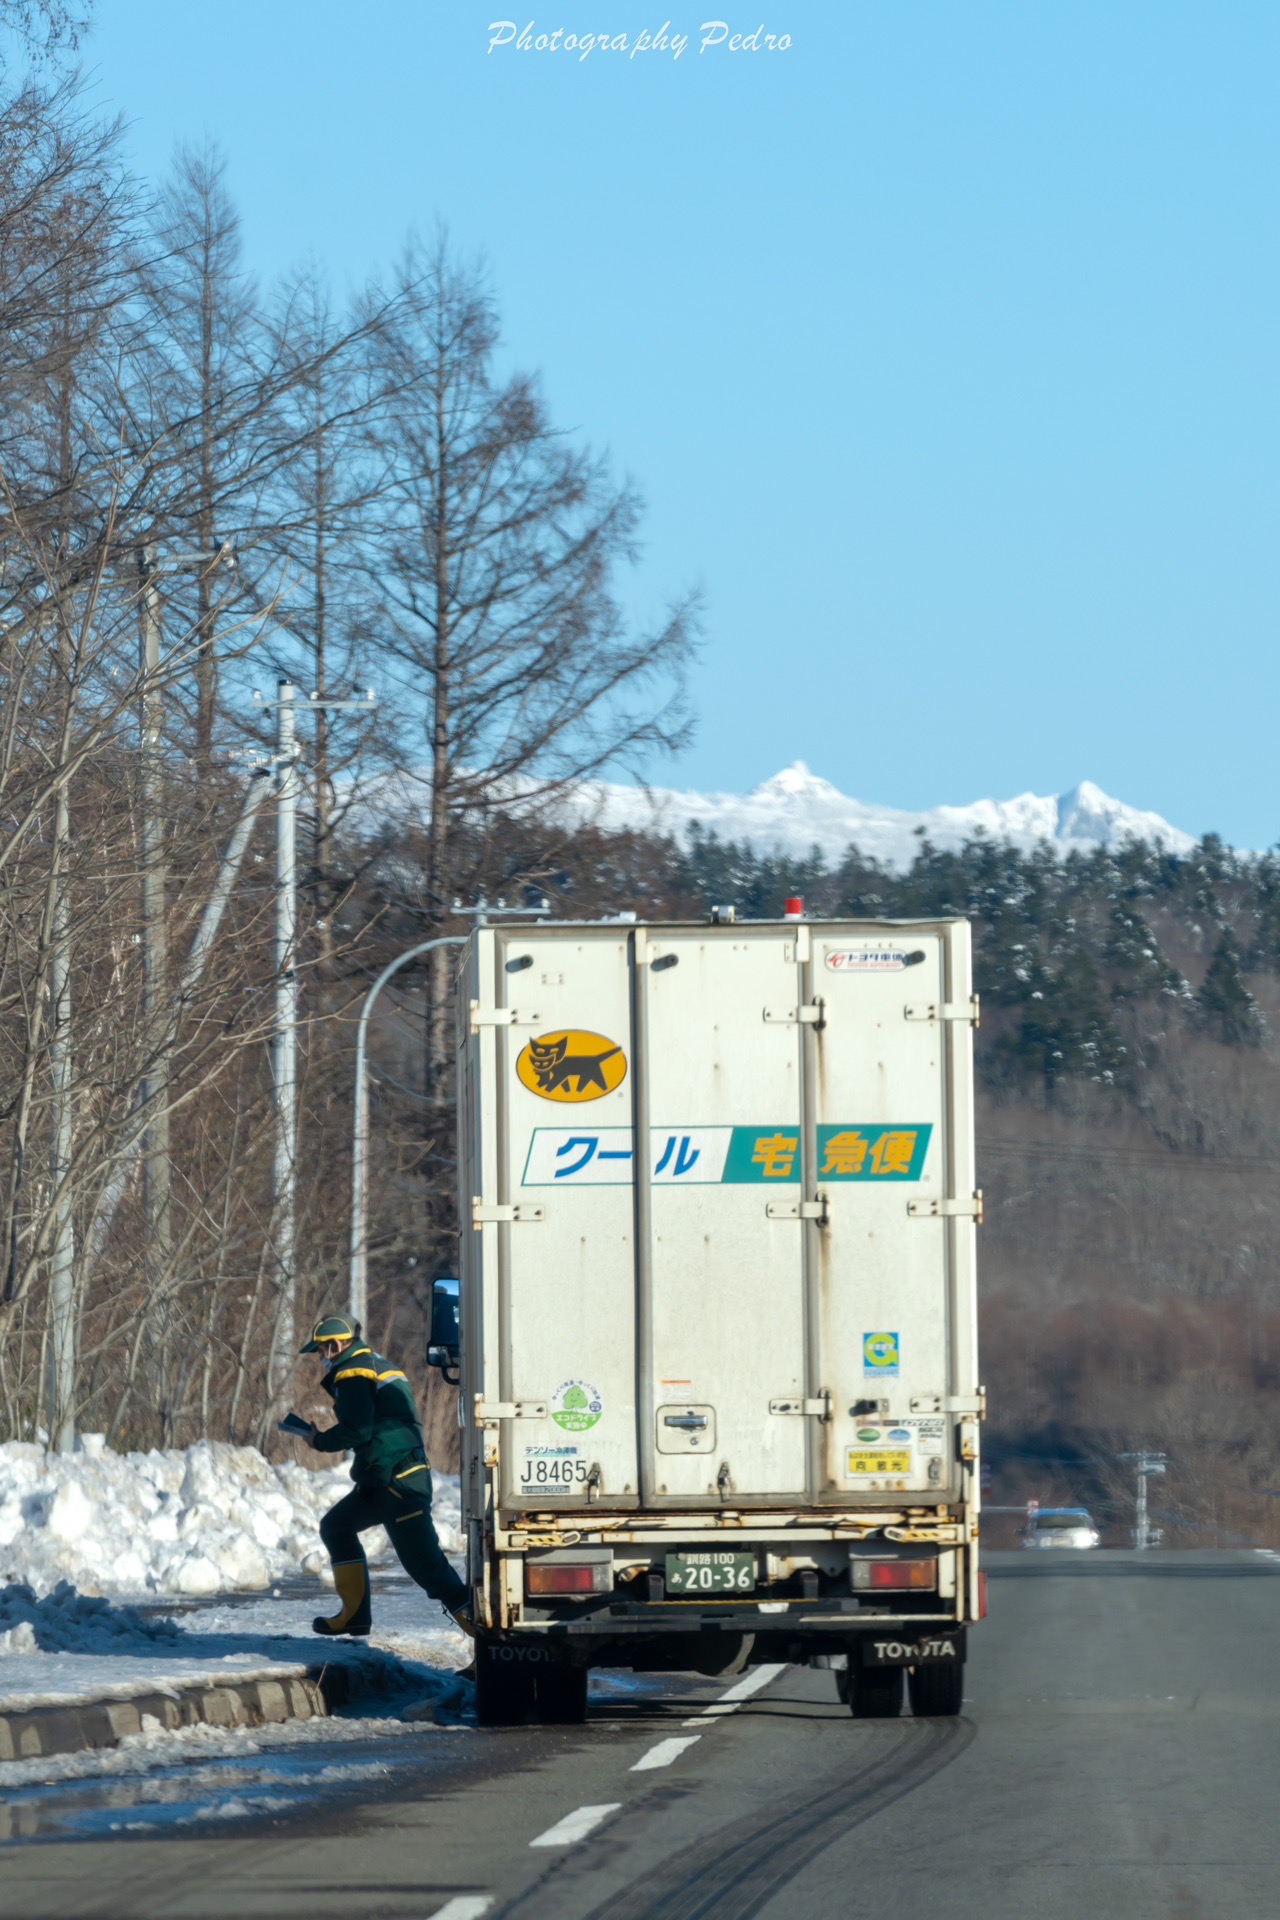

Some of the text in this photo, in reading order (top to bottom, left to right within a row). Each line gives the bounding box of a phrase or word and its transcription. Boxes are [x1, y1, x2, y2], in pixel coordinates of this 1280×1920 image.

[520, 1460, 587, 1482] J8465
[714, 1553, 735, 1564] 100
[685, 1566, 750, 1589] 20-36
[488, 1646, 555, 1661] TOYOT
